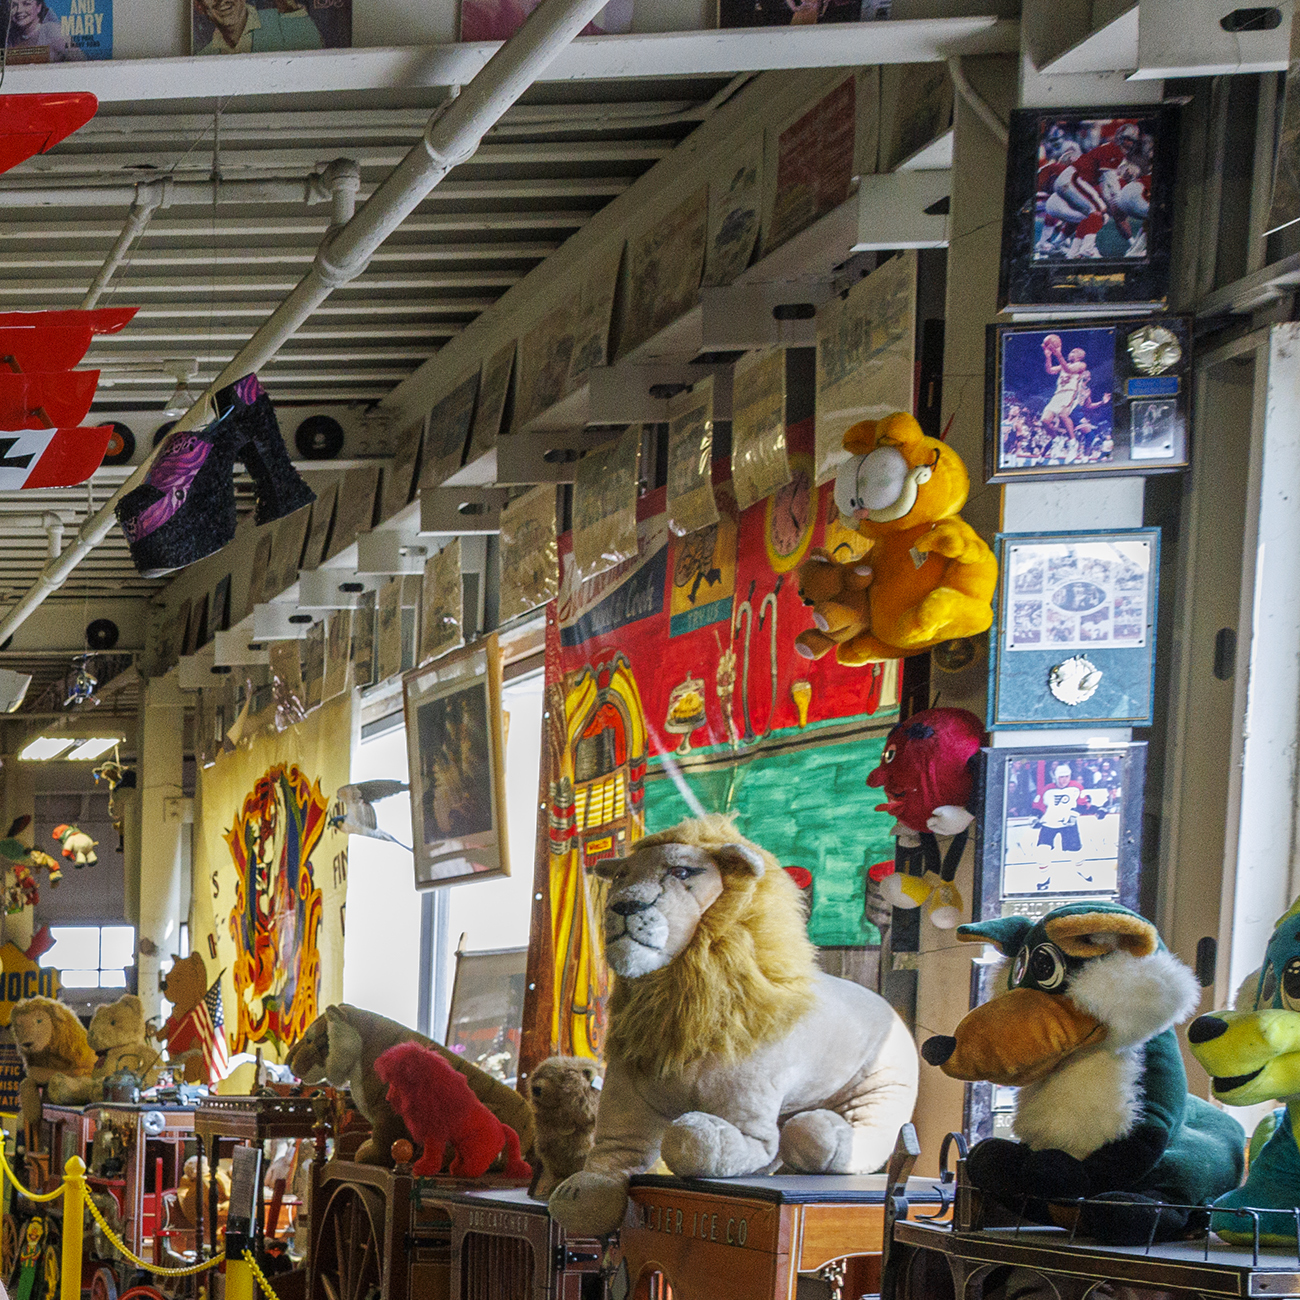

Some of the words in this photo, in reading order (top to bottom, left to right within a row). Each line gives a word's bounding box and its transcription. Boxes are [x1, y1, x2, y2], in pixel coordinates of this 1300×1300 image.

[60, 13, 104, 37] MARY
[693, 1212, 718, 1241] ICE
[726, 1218, 748, 1246] CO
